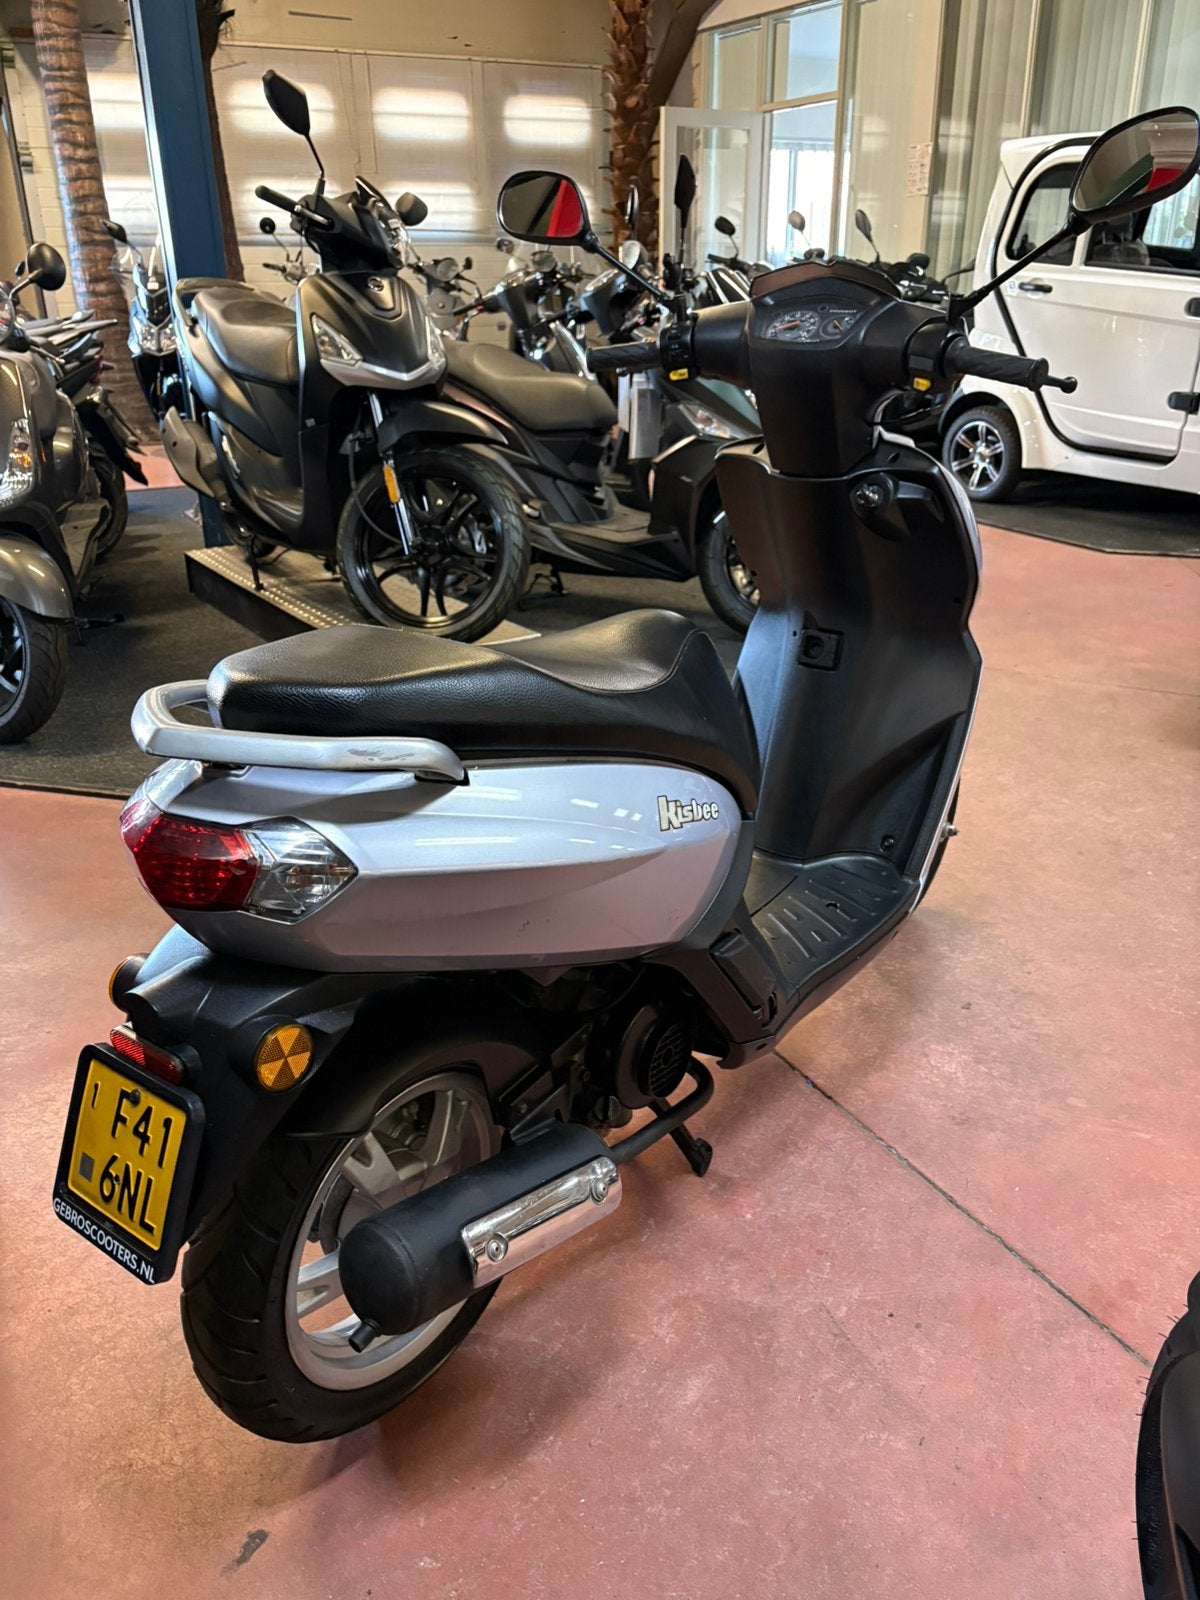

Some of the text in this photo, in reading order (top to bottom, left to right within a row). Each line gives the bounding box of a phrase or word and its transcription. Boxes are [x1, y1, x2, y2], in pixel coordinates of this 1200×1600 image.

[91, 1082, 100, 1109] 1
[111, 1088, 172, 1168] F41
[100, 1154, 155, 1235] 6NL
[53, 1197, 155, 1284] GEBROSCOOTERS.NL
